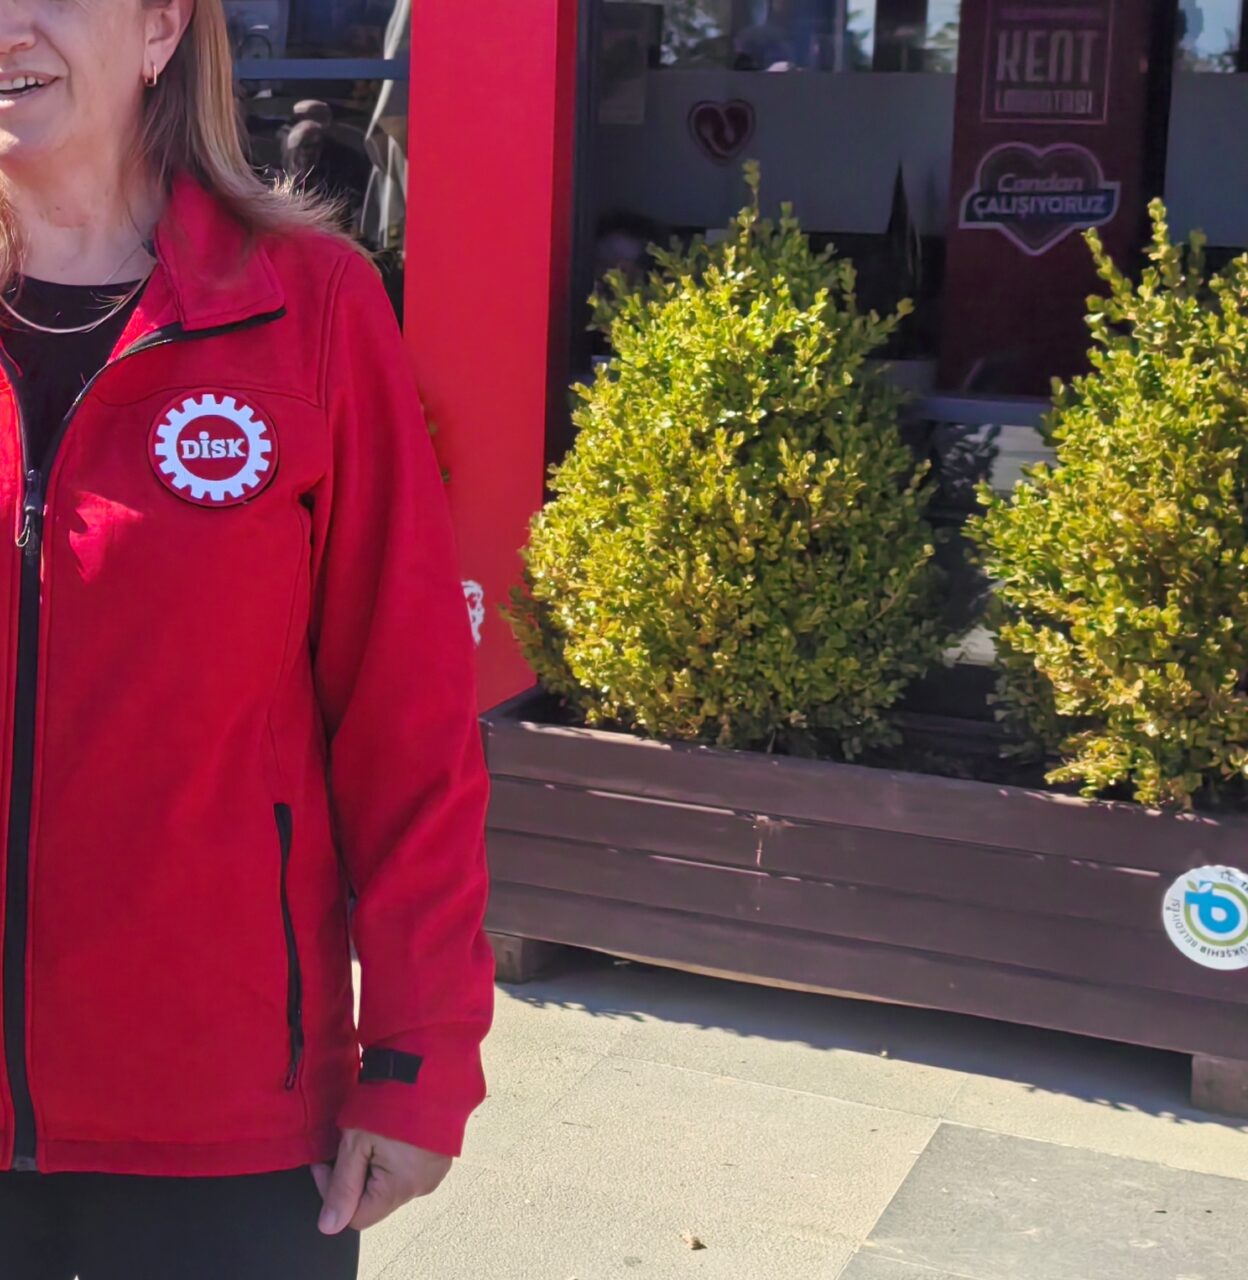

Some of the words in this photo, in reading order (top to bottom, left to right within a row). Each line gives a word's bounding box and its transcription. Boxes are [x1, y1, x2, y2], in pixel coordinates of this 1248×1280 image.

[996, 28, 1099, 83] KENT
[973, 195, 1107, 220] ÇALIŞIYORUZ
[180, 431, 246, 459] DİSK
